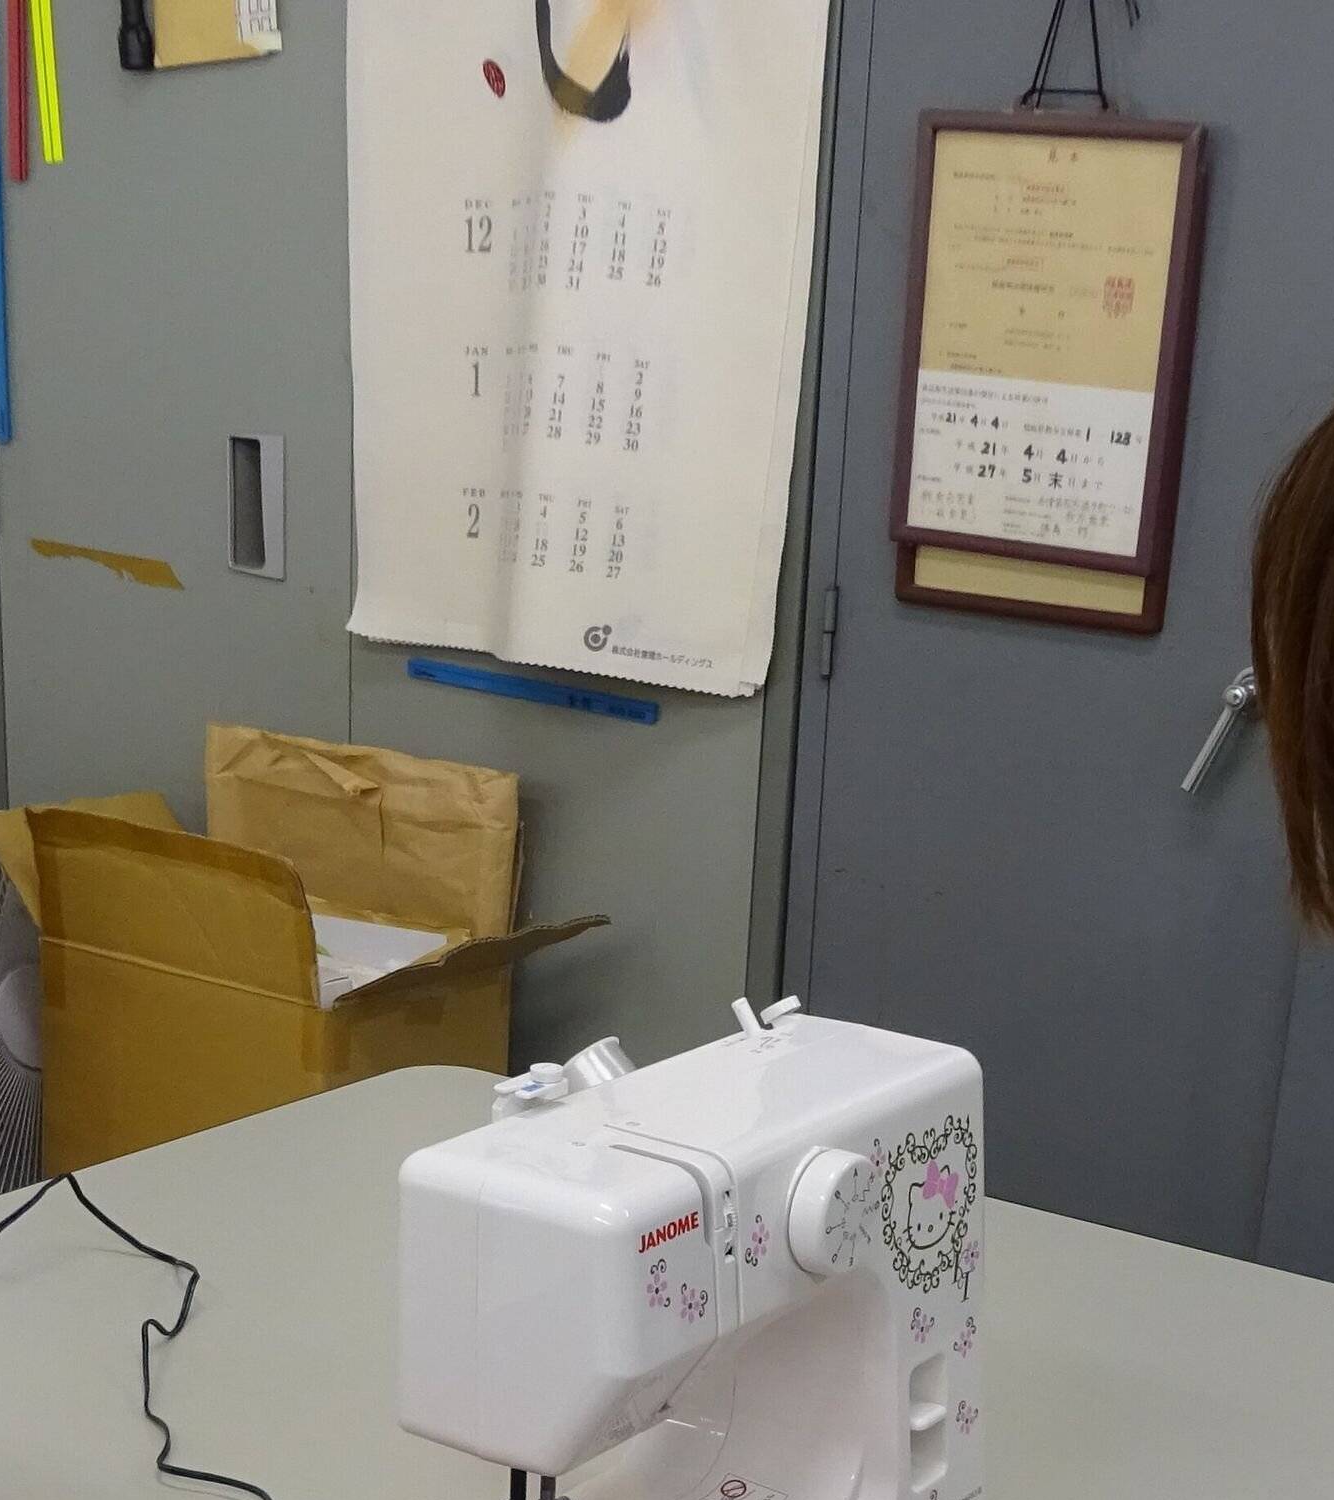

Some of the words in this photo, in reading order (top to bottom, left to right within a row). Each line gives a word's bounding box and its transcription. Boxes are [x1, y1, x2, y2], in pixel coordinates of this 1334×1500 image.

[579, 207, 586, 221] 3
[465, 215, 492, 253] 12
[574, 224, 589, 239] 10
[614, 230, 626, 245] 11
[653, 238, 667, 254] 12
[572, 241, 586, 255] 17
[611, 247, 625, 263] 18
[650, 255, 664, 270] 19
[566, 275, 580, 290] 31
[568, 258, 583, 273] 24
[608, 265, 624, 280] 25
[646, 273, 661, 288] 26
[472, 361, 480, 397] 1
[557, 375, 565, 388] 7
[595, 381, 604, 394] 8
[635, 372, 643, 385] 2
[553, 391, 566, 405] 14
[591, 398, 605, 413] 15
[629, 404, 643, 419] 16
[548, 407, 562, 423] 21
[588, 415, 603, 429] 22
[626, 420, 641, 436] 23
[547, 425, 561, 439] 28
[585, 431, 601, 445] 29
[623, 437, 639, 451] 30
[467, 503, 480, 539] 2
[540, 506, 547, 518] 4
[578, 511, 586, 524] 5
[615, 517, 623, 531] 6
[534, 537, 548, 552] 18
[572, 543, 586, 557] 19
[608, 550, 623, 564] 20
[575, 527, 588, 542] 12
[611, 533, 625, 547] 13
[531, 553, 546, 568] 25
[568, 560, 584, 573] 26
[605, 566, 621, 579] 27
[638, 1210, 700, 1254] JANOME
